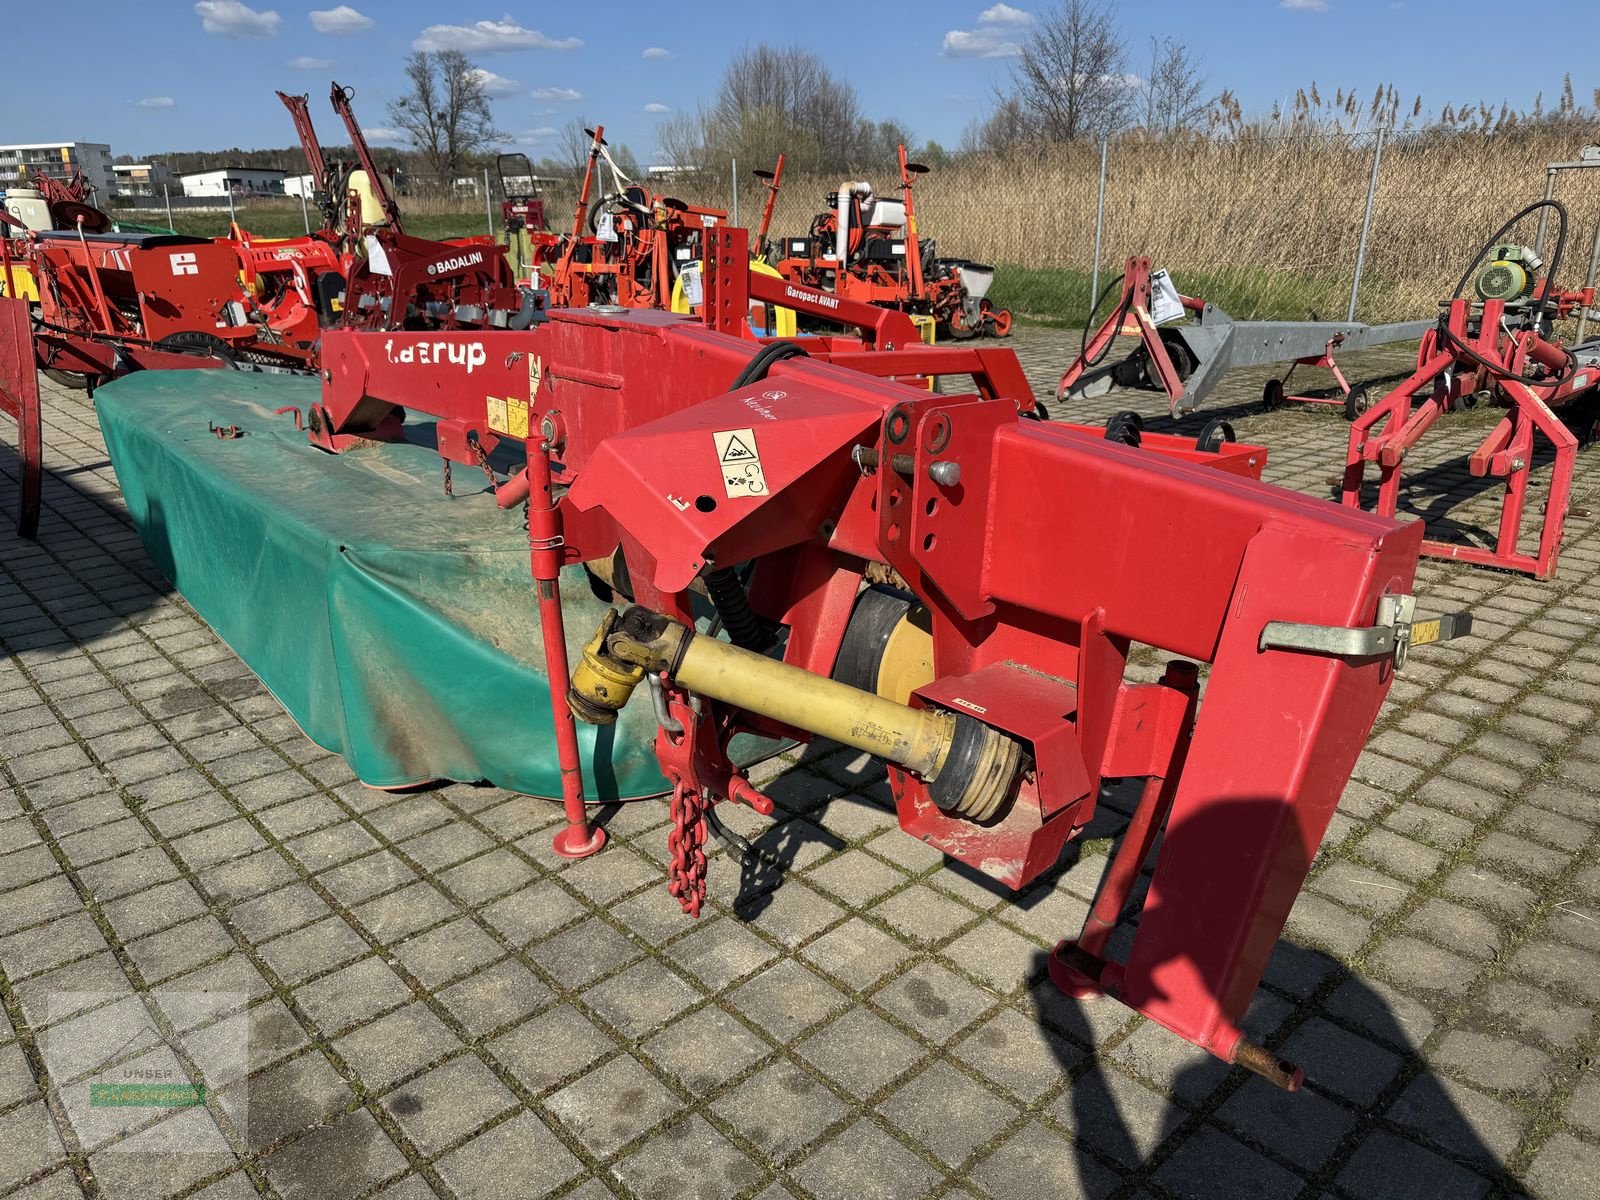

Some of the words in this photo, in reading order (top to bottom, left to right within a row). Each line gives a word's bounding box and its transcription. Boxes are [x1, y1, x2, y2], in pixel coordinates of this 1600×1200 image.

[435, 251, 483, 274] BADALINI
[787, 285, 819, 304] Garopact
[818, 295, 840, 309] AVANT
